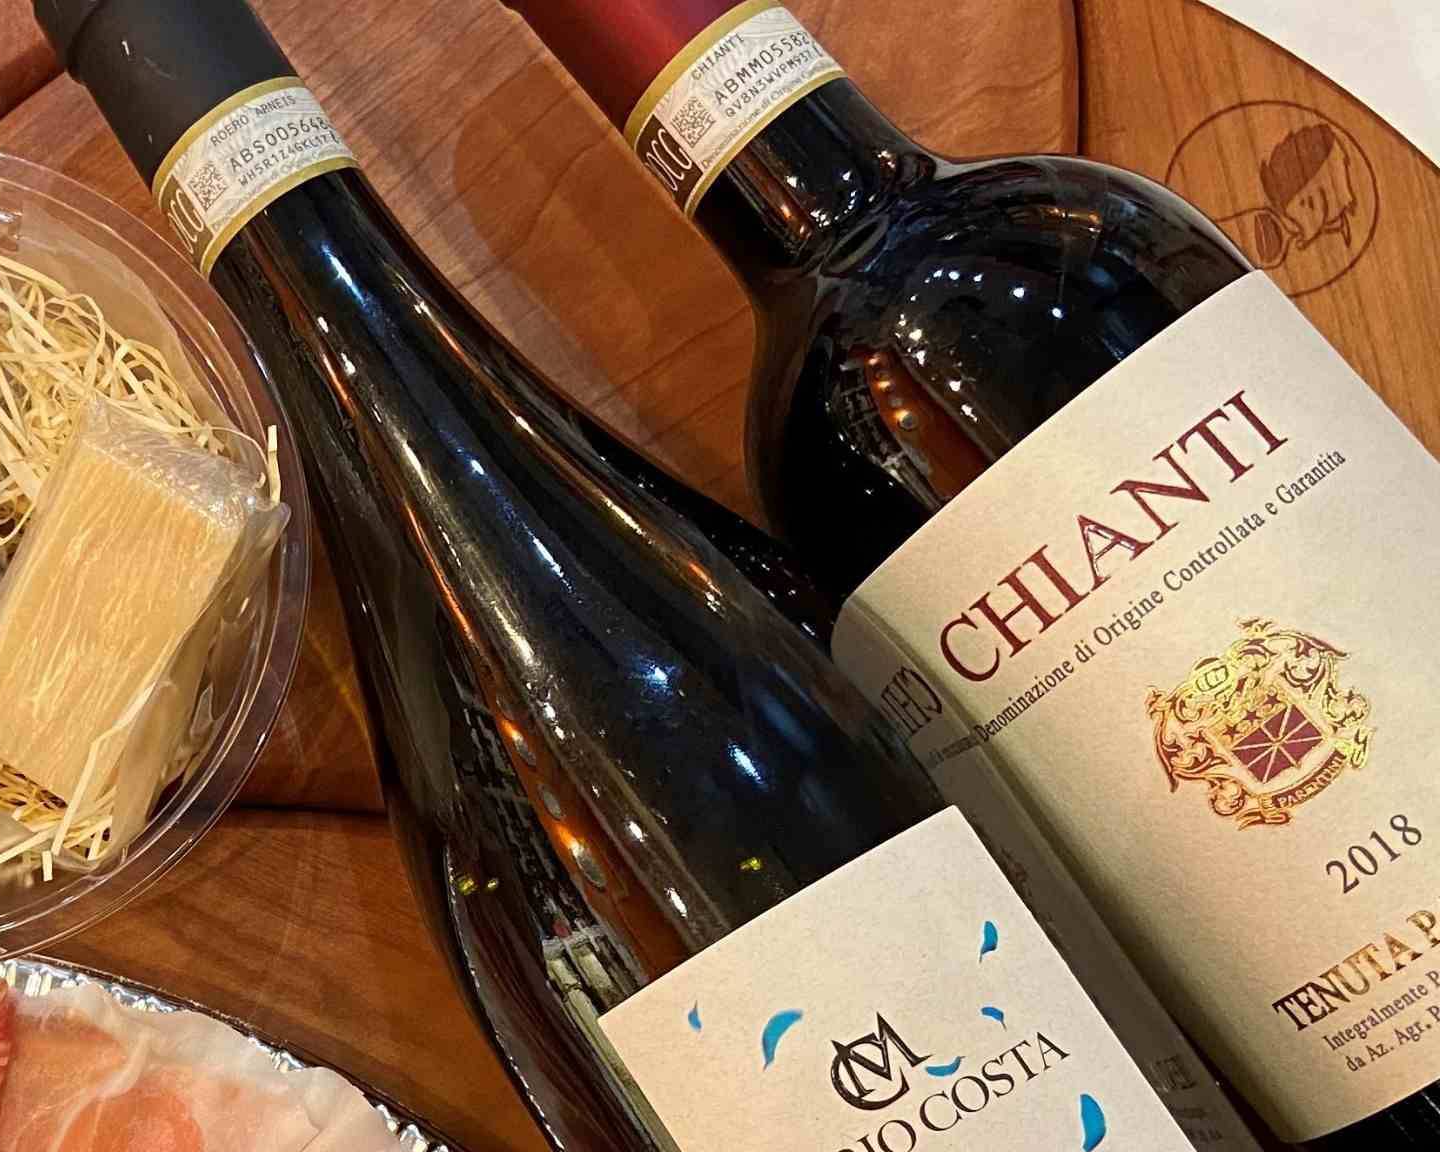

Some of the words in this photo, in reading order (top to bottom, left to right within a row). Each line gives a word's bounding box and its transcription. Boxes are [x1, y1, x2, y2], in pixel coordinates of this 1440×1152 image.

[692, 33, 745, 81] CHIANTI
[210, 113, 250, 147] ROERO
[255, 95, 297, 116] ARNEIS
[939, 389, 1289, 683] CHIANTI
[973, 659, 1075, 743] Denominazione
[1074, 639, 1097, 664] di
[1093, 590, 1165, 647] Origine
[1162, 511, 1266, 592] Controllata
[1264, 501, 1279, 516] e
[1275, 450, 1347, 505] Garantita
[1325, 813, 1423, 895] 2018
[1271, 931, 1424, 1033] TENUTA
[1322, 982, 1429, 1051] Integralmente
[917, 1030, 1072, 1134] COSTA
[1345, 1054, 1367, 1073] da
[1365, 1041, 1395, 1062] Az.
[1394, 1020, 1432, 1046] Agr.
